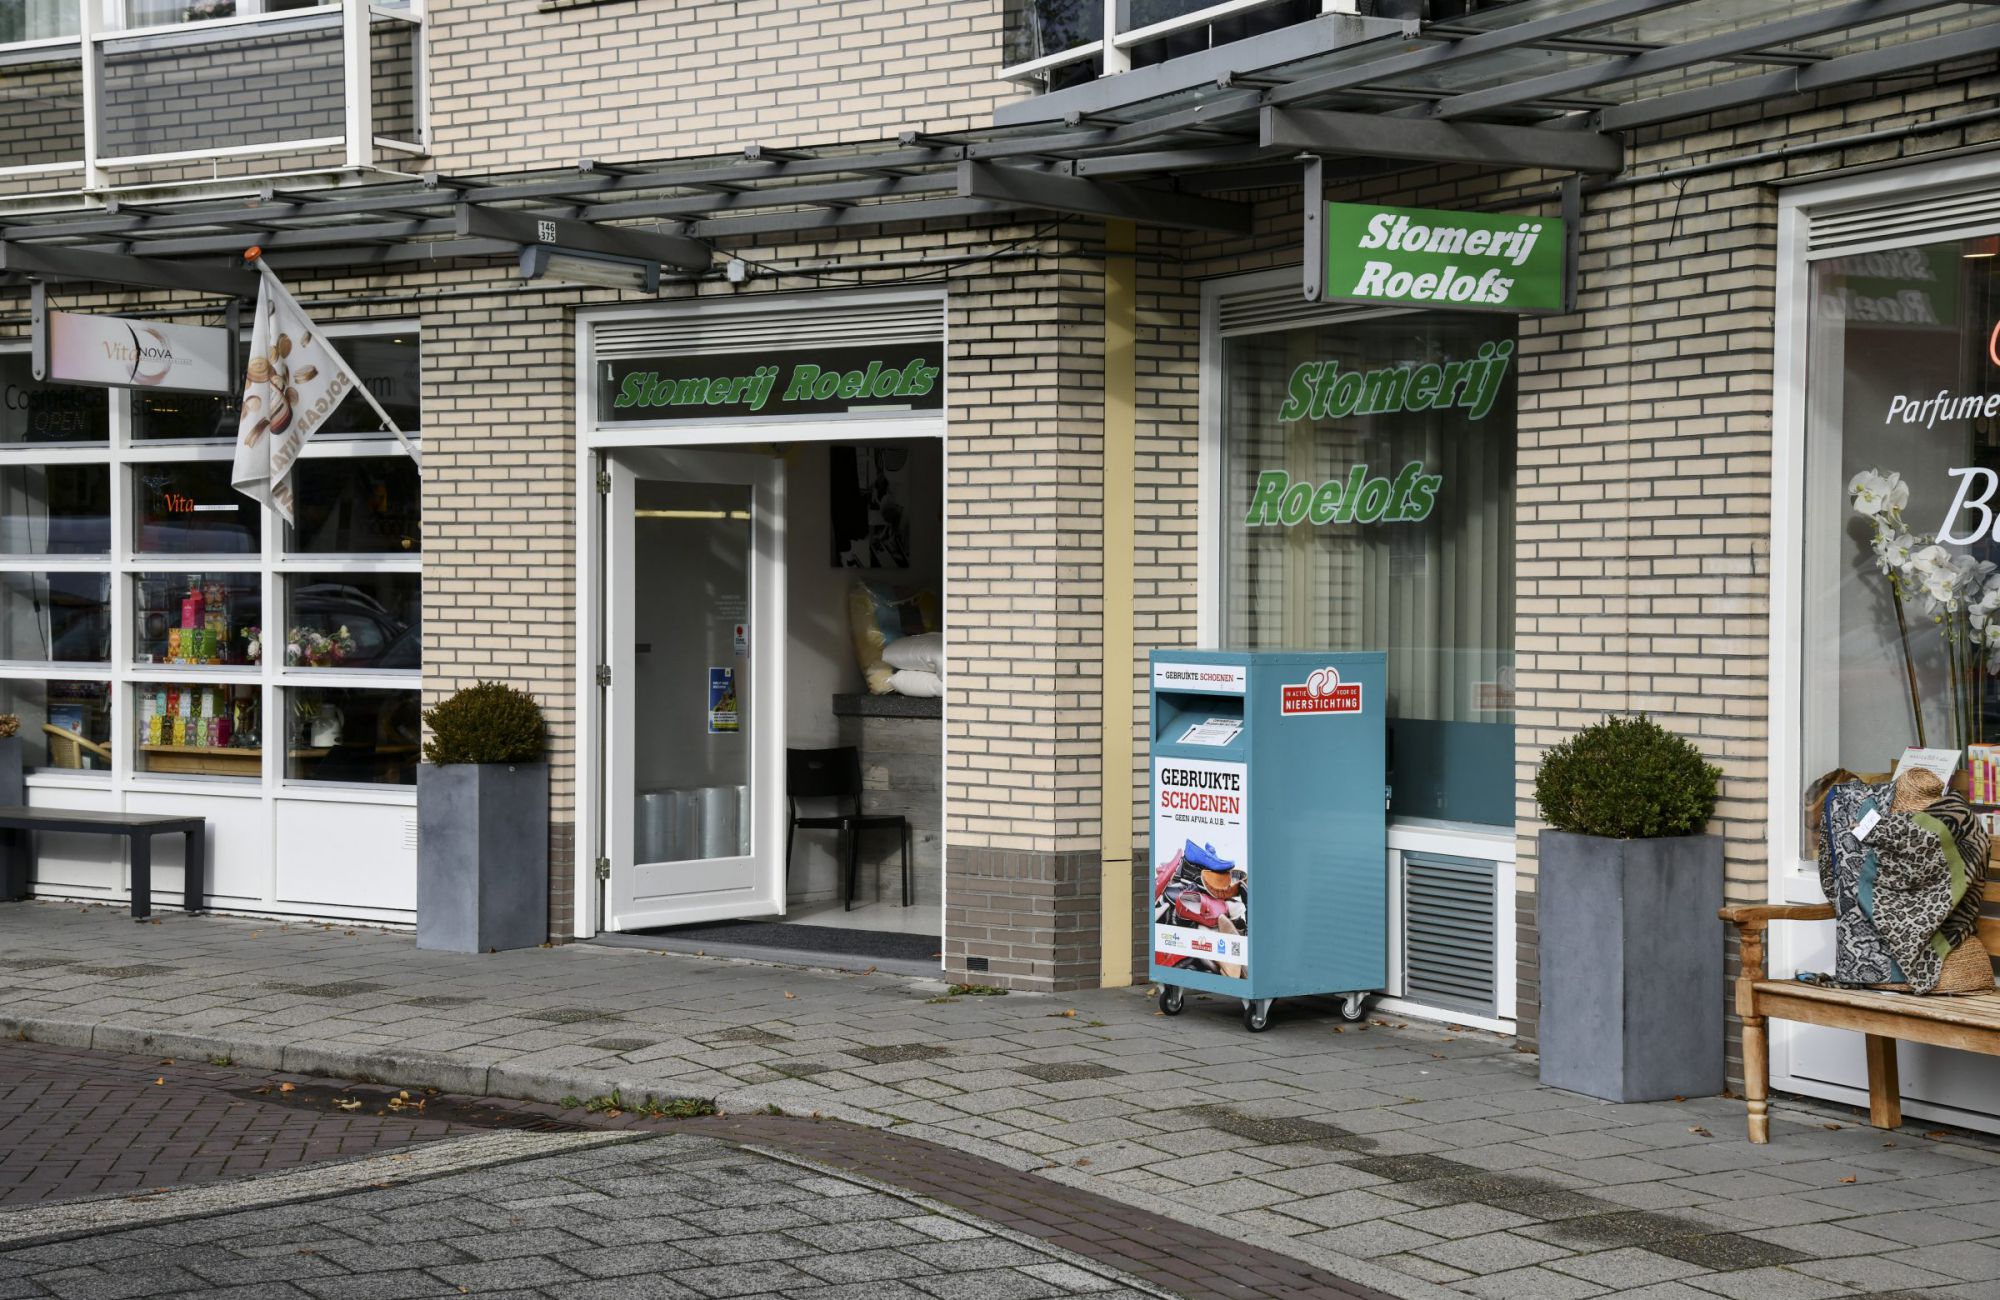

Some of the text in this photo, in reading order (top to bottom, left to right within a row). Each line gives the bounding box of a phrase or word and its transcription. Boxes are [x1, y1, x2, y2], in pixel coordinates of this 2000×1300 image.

[540, 222, 555, 232] 146
[540, 231, 555, 241] 375
[1358, 213, 1543, 266] Stomerij
[1352, 260, 1515, 304] Roelofs
[139, 346, 173, 360] NOVA
[614, 358, 939, 411] Stomerij Roelofs
[1278, 339, 1514, 422] Stomerij
[1885, 390, 2000, 429] Parfume
[34, 410, 87, 432] OPEN
[164, 494, 194, 512] Vita
[1245, 460, 1442, 526] Roelofs
[1165, 671, 1234, 682] GEBRUIKTE SCHOENEN
[1285, 698, 1357, 710] NIERSTICHTING
[1161, 768, 1240, 791] GEBRUIKTE
[1161, 790, 1240, 814] SCHOENEN
[1174, 813, 1226, 826] GEEN AFVAL A.U.B.
